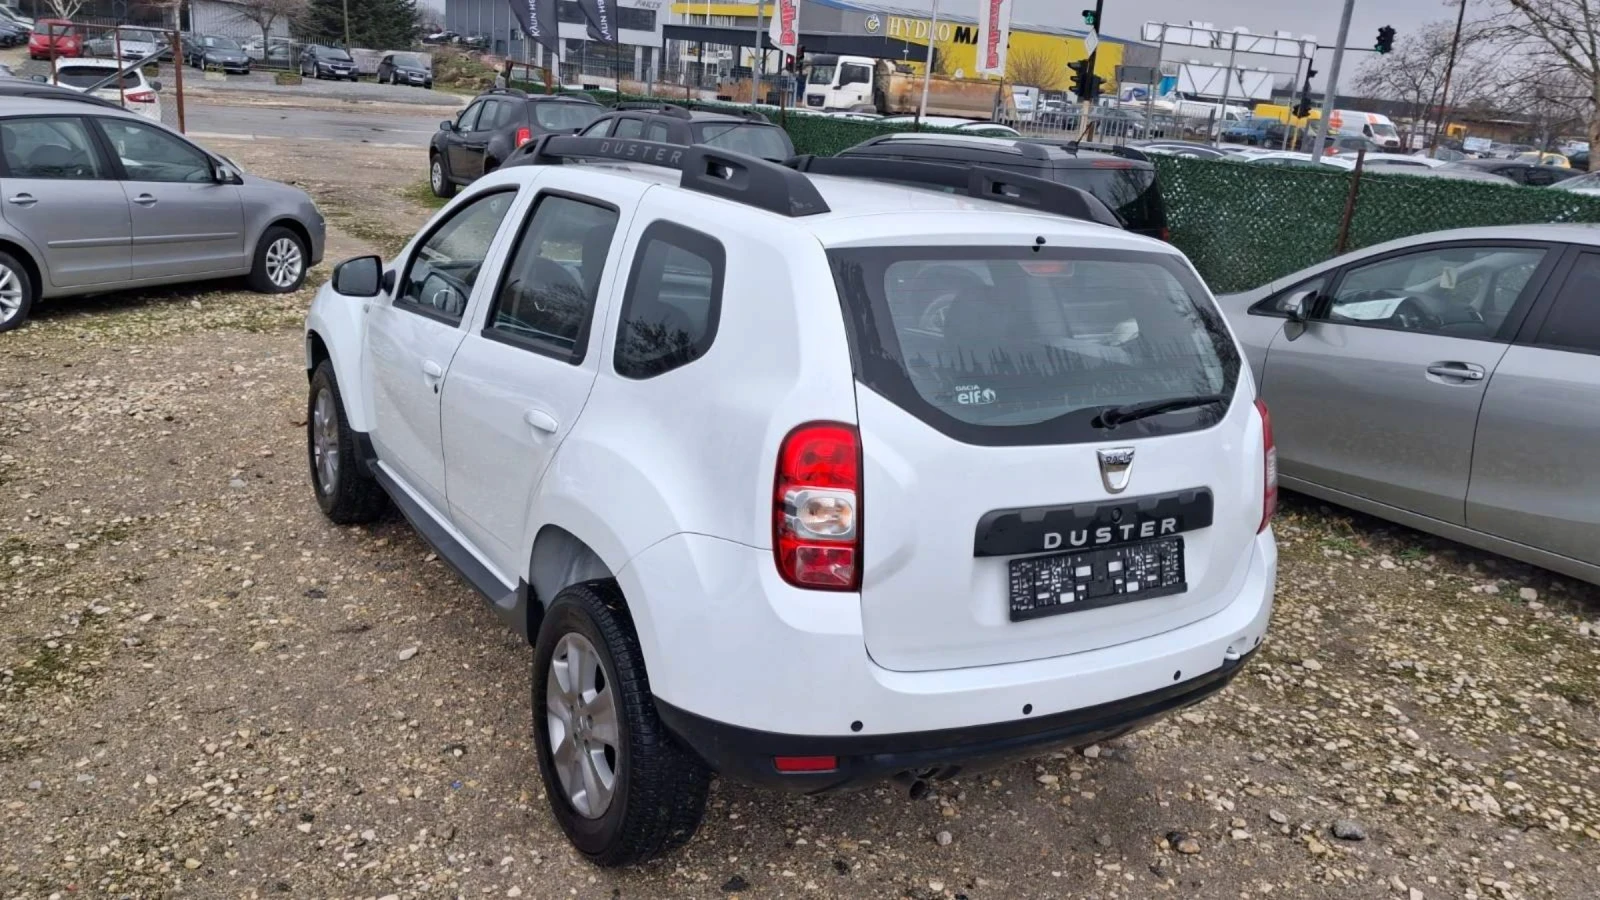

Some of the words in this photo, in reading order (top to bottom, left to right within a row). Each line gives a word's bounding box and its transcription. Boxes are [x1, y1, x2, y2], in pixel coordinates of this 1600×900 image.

[600, 141, 682, 163] DUSTER
[957, 390, 981, 405] elf
[1043, 517, 1177, 550] DUSTER
